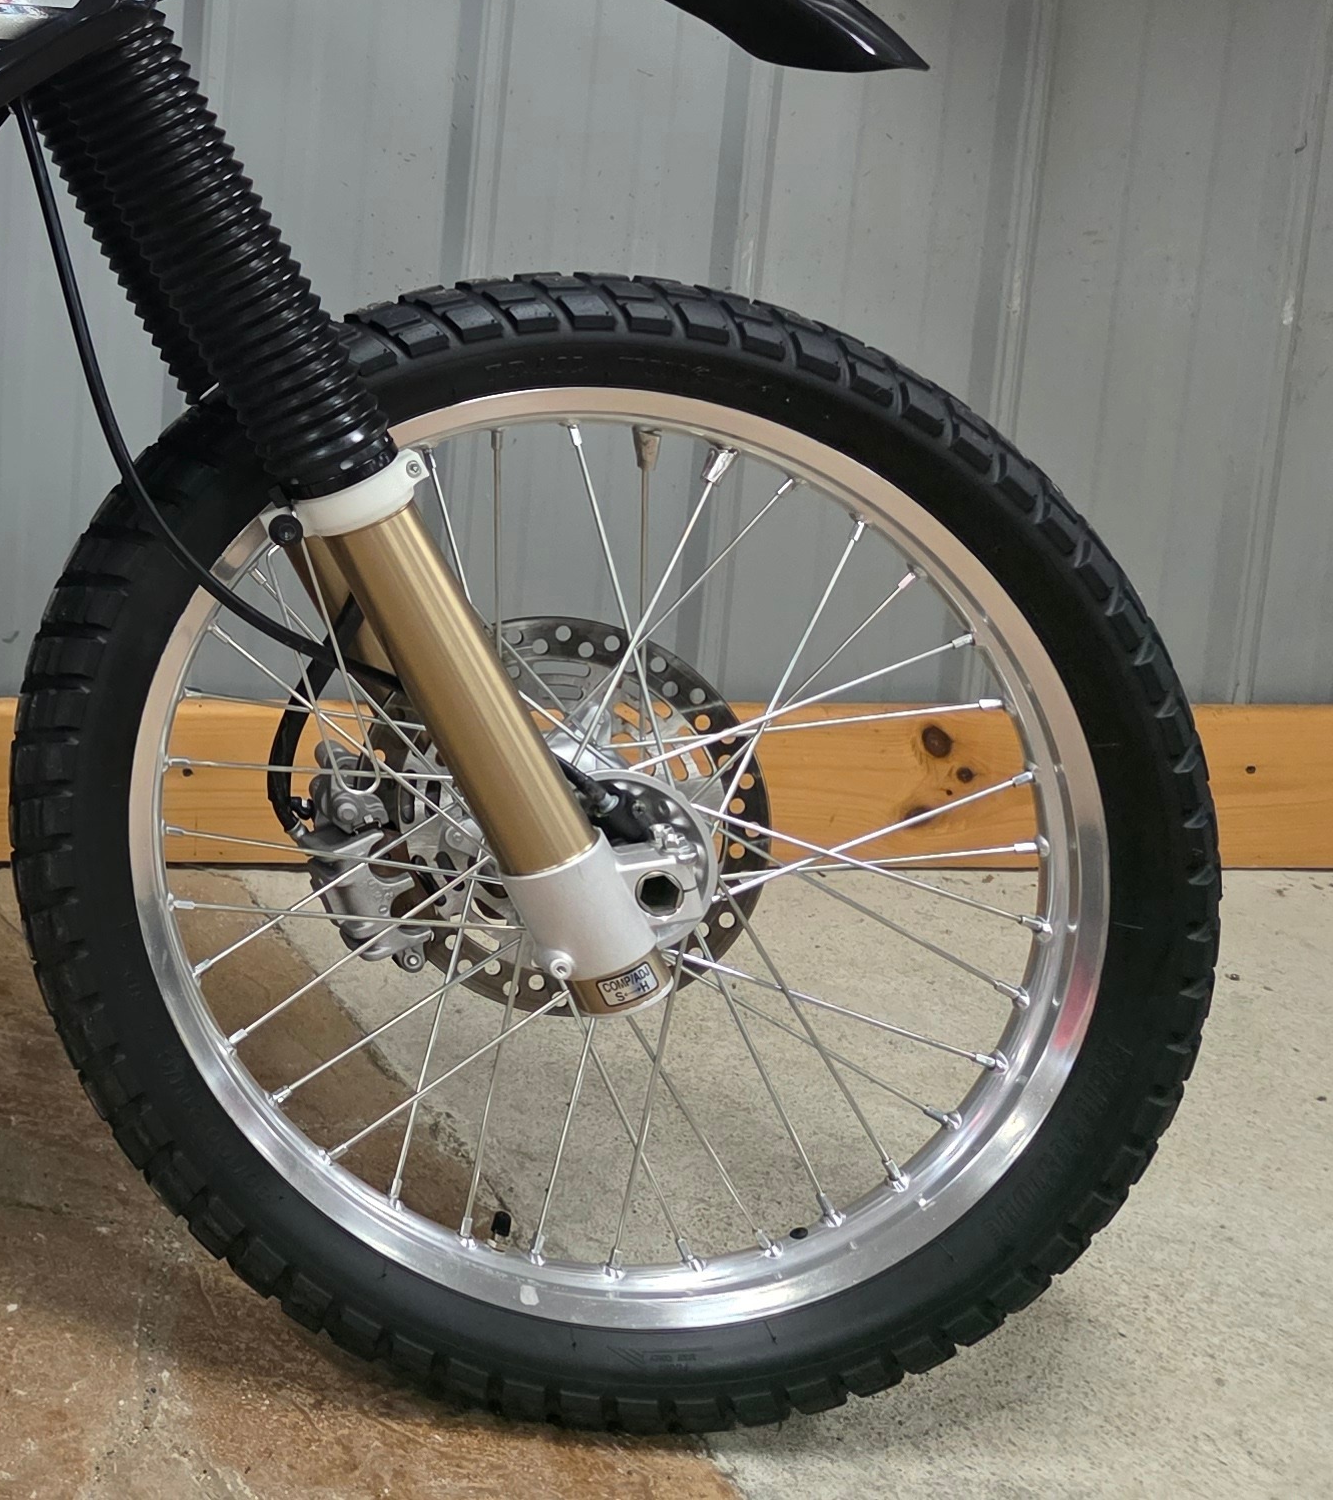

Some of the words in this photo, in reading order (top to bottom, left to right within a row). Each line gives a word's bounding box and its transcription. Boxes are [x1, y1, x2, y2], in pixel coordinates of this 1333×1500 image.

[602, 965, 650, 993] COMP/ADJ
[614, 991, 625, 1002] S
[639, 980, 650, 993] H
